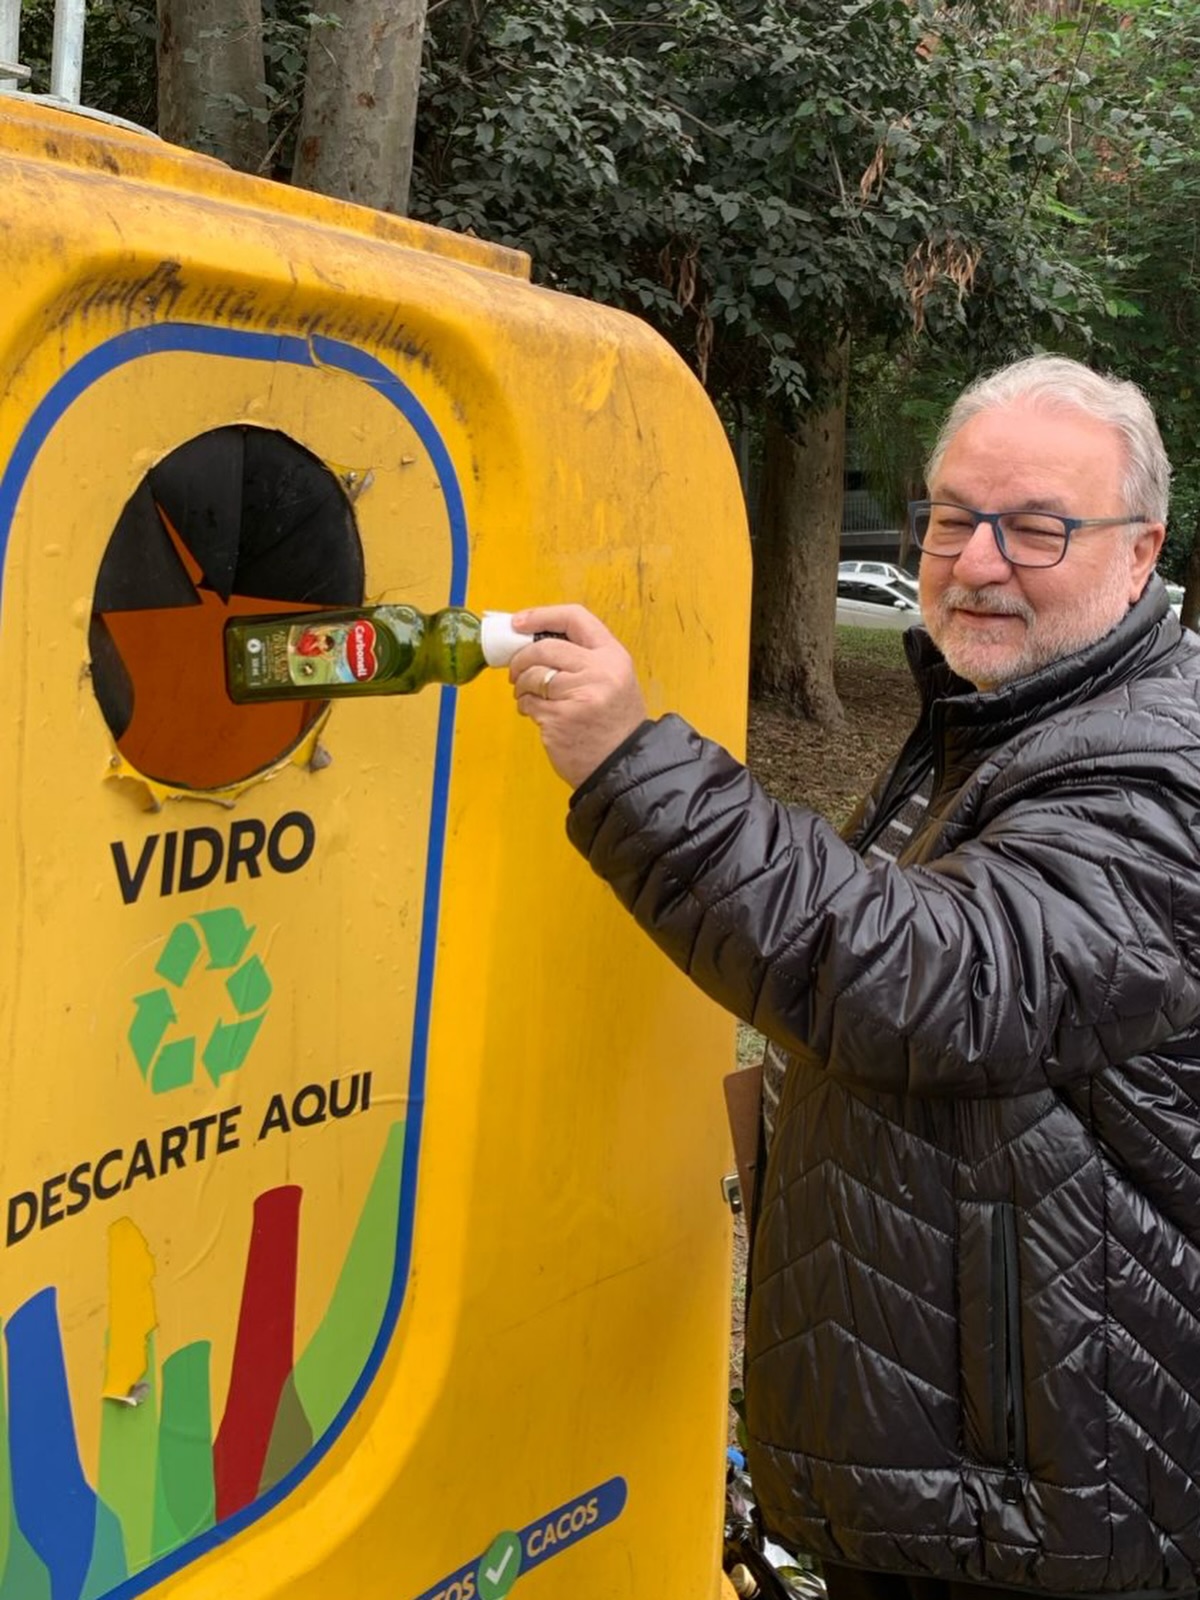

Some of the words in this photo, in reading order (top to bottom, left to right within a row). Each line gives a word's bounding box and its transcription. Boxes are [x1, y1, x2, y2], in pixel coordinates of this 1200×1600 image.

[354, 625, 368, 677] Carbonell
[110, 811, 315, 905] VIDRO
[6, 1105, 242, 1248] DESCARTE
[258, 1072, 372, 1140] AQUI
[526, 1497, 598, 1558] CACOS
